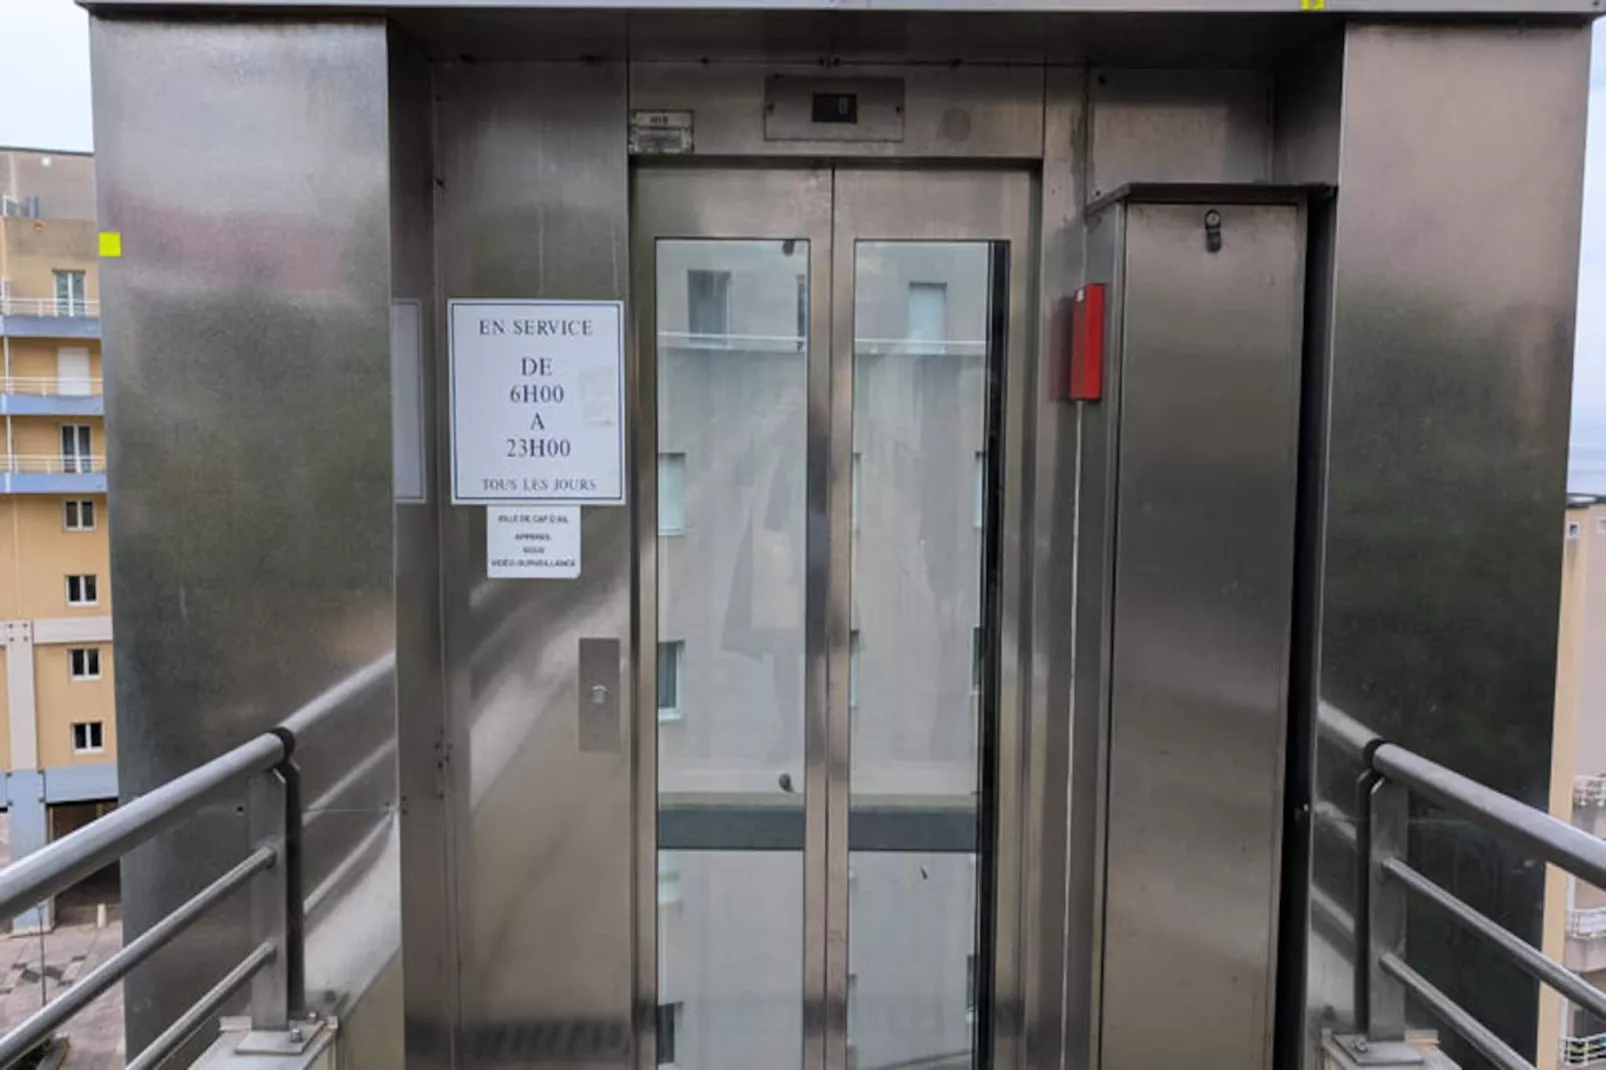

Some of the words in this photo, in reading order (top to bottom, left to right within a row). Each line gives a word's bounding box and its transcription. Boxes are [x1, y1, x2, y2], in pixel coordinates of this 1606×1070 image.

[479, 319, 505, 336] EN
[513, 319, 593, 336] SERVICE
[521, 357, 553, 376] DE
[510, 384, 565, 404] 6H00
[530, 411, 546, 431] A
[506, 438, 571, 458] 23H00
[482, 478, 517, 491] TOUS
[523, 478, 549, 491] LES
[555, 478, 597, 491] JOURS
